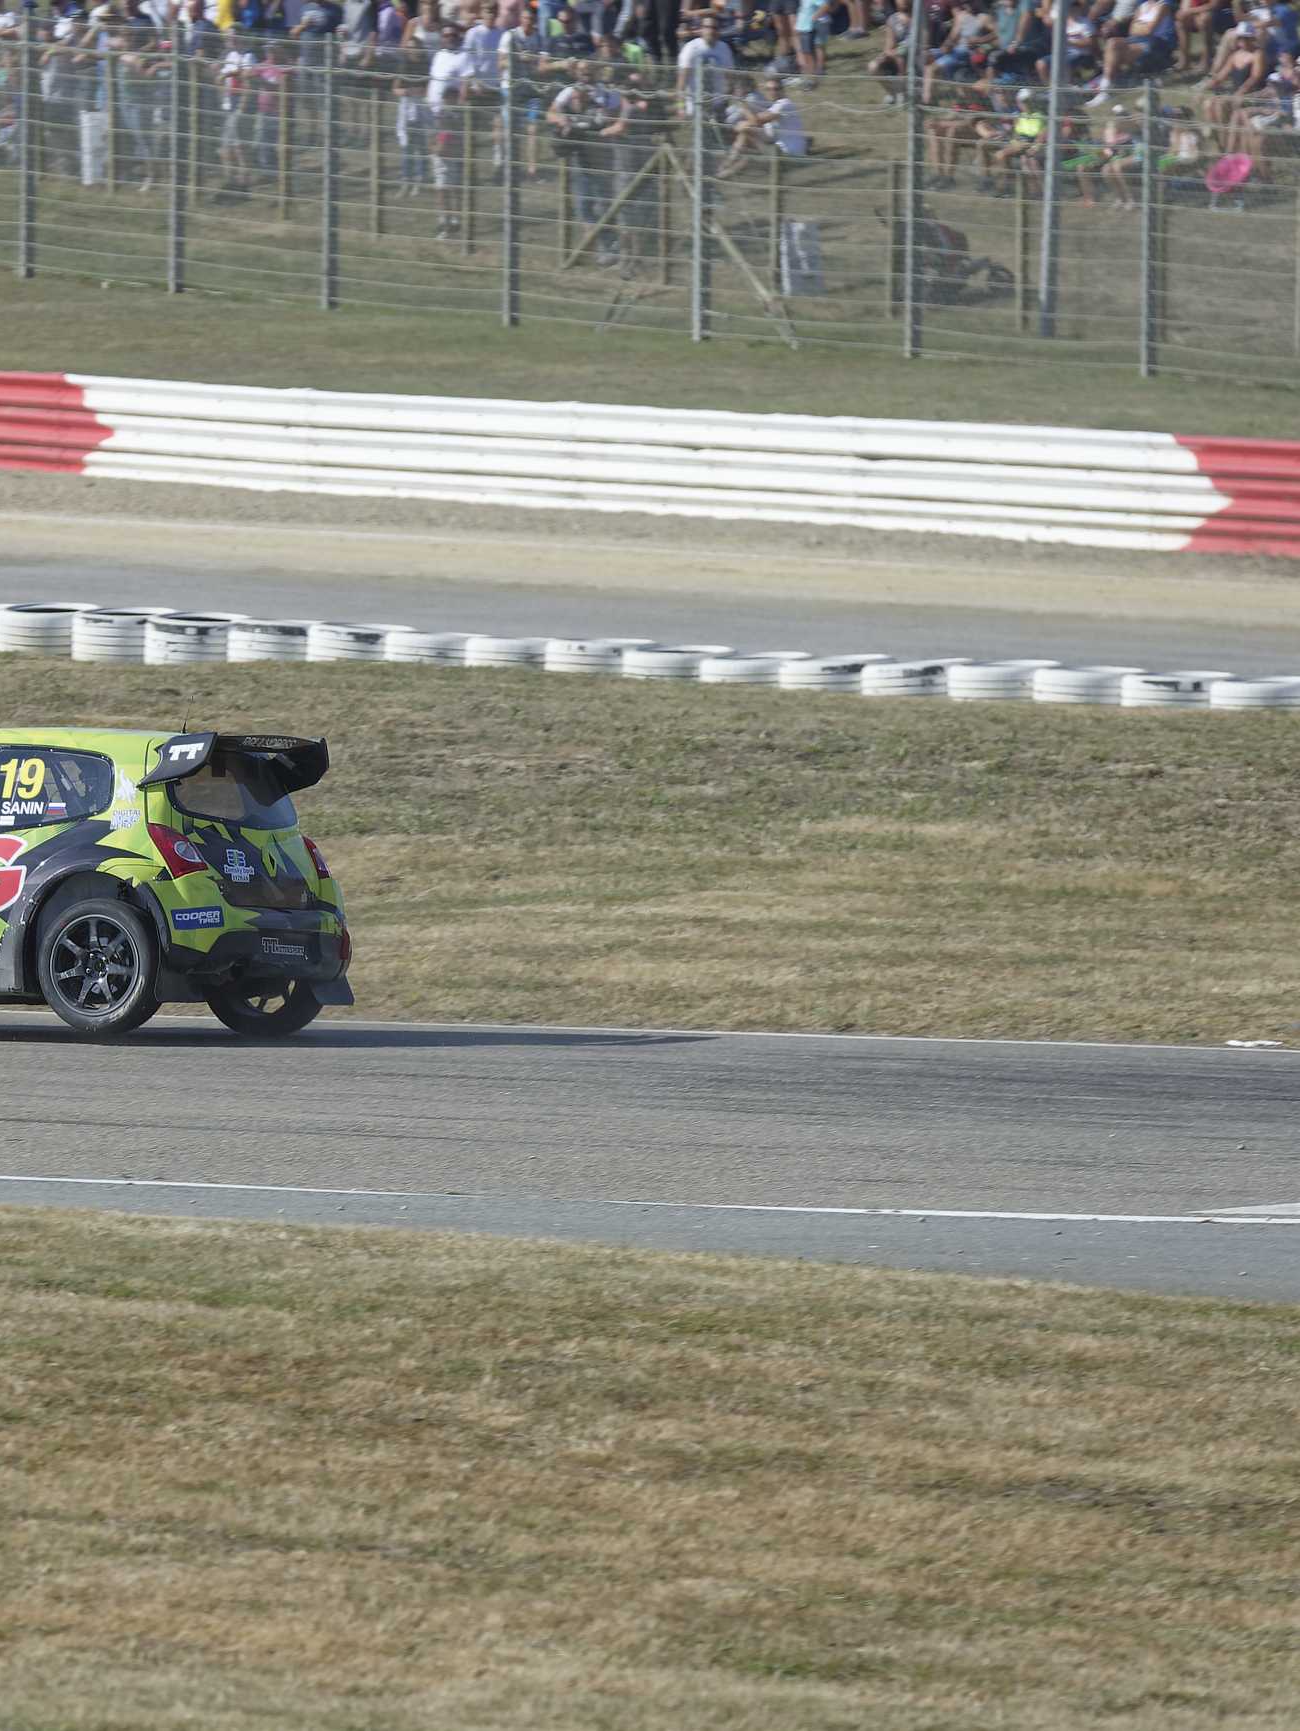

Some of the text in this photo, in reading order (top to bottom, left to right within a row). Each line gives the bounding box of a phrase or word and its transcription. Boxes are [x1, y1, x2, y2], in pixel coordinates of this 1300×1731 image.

[168, 742, 205, 761] TT
[0, 758, 46, 800] 19
[175, 910, 220, 921] COOPER
